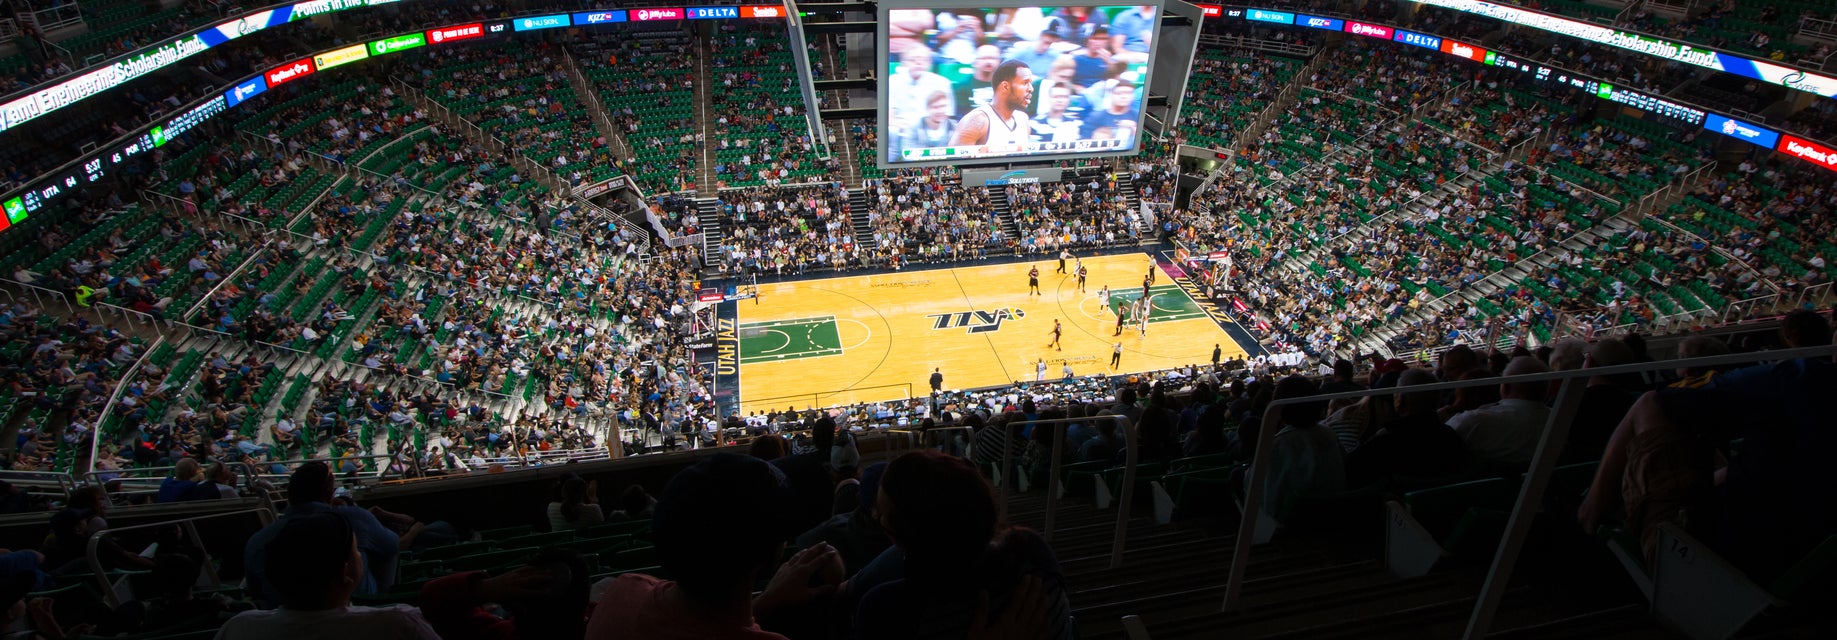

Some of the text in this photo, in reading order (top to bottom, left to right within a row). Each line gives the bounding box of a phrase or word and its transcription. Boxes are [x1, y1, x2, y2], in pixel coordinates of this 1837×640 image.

[296, 2, 331, 18] Points
[700, 8, 736, 16] DELTA
[1406, 33, 1438, 48] DELTA
[1540, 17, 1605, 43] Engineering
[1604, 28, 1676, 58] Scholarship
[1678, 46, 1716, 66] Fund
[1506, 60, 1518, 69] UTA
[10, 96, 41, 124] and
[40, 70, 118, 112] Engineering
[115, 46, 176, 81] Scholarship
[175, 35, 203, 61] Fund
[1571, 79, 1584, 87] POR
[112, 144, 140, 163] 45 POR
[1787, 141, 1827, 163] KeyBank
[84, 159, 101, 174] 5:37
[42, 176, 77, 199] UTA 64
[718, 318, 738, 342] JAZZ
[718, 344, 736, 375] UTAH
